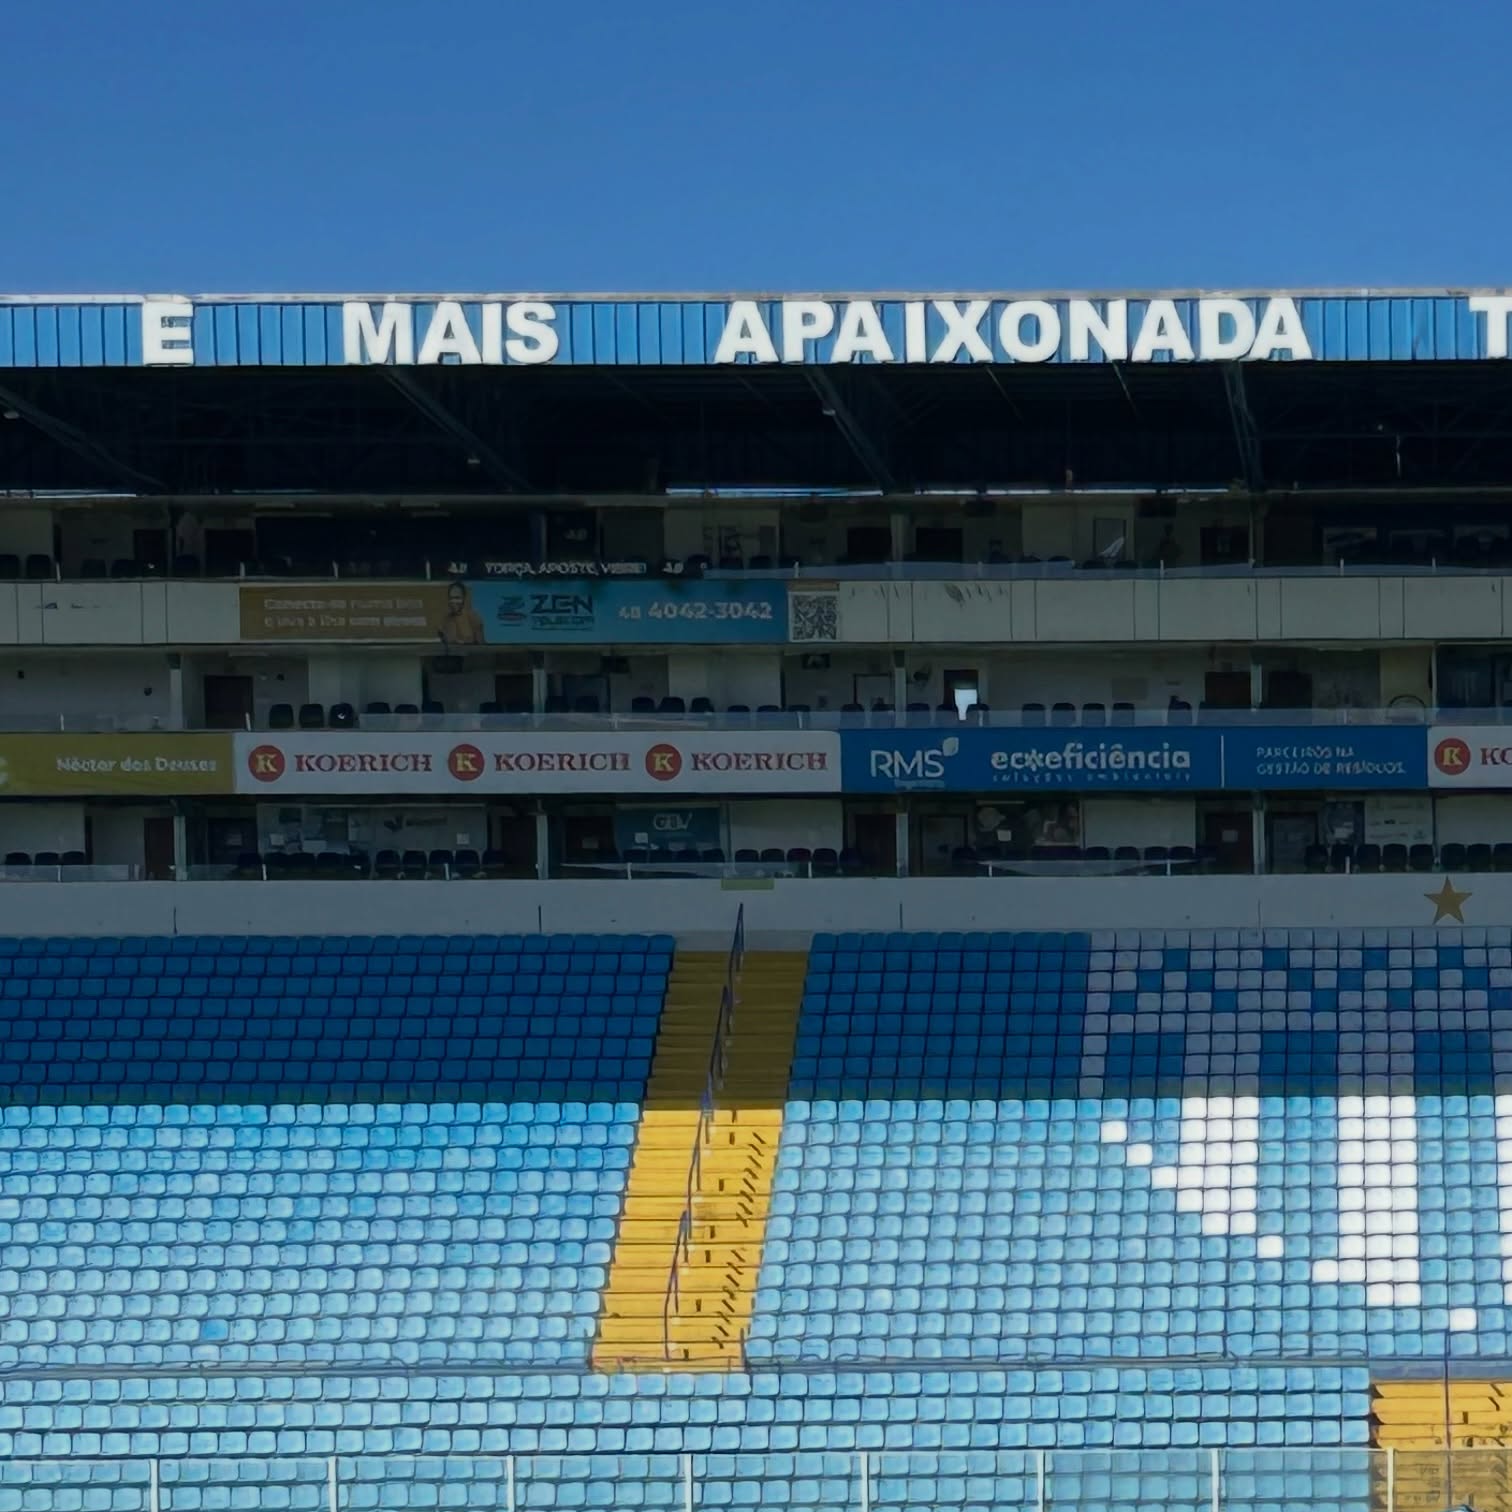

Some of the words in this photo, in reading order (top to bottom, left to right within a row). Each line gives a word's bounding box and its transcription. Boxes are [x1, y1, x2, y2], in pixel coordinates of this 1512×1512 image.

[142, 295, 195, 366] E
[343, 300, 559, 365] MAIS
[714, 296, 1312, 363] APAIXONADA
[530, 594, 593, 613] ZEN
[294, 753, 433, 773] KOERICH
[494, 752, 631, 772] KOERICH
[690, 752, 829, 772] KOERICH
[869, 749, 945, 778] RMS
